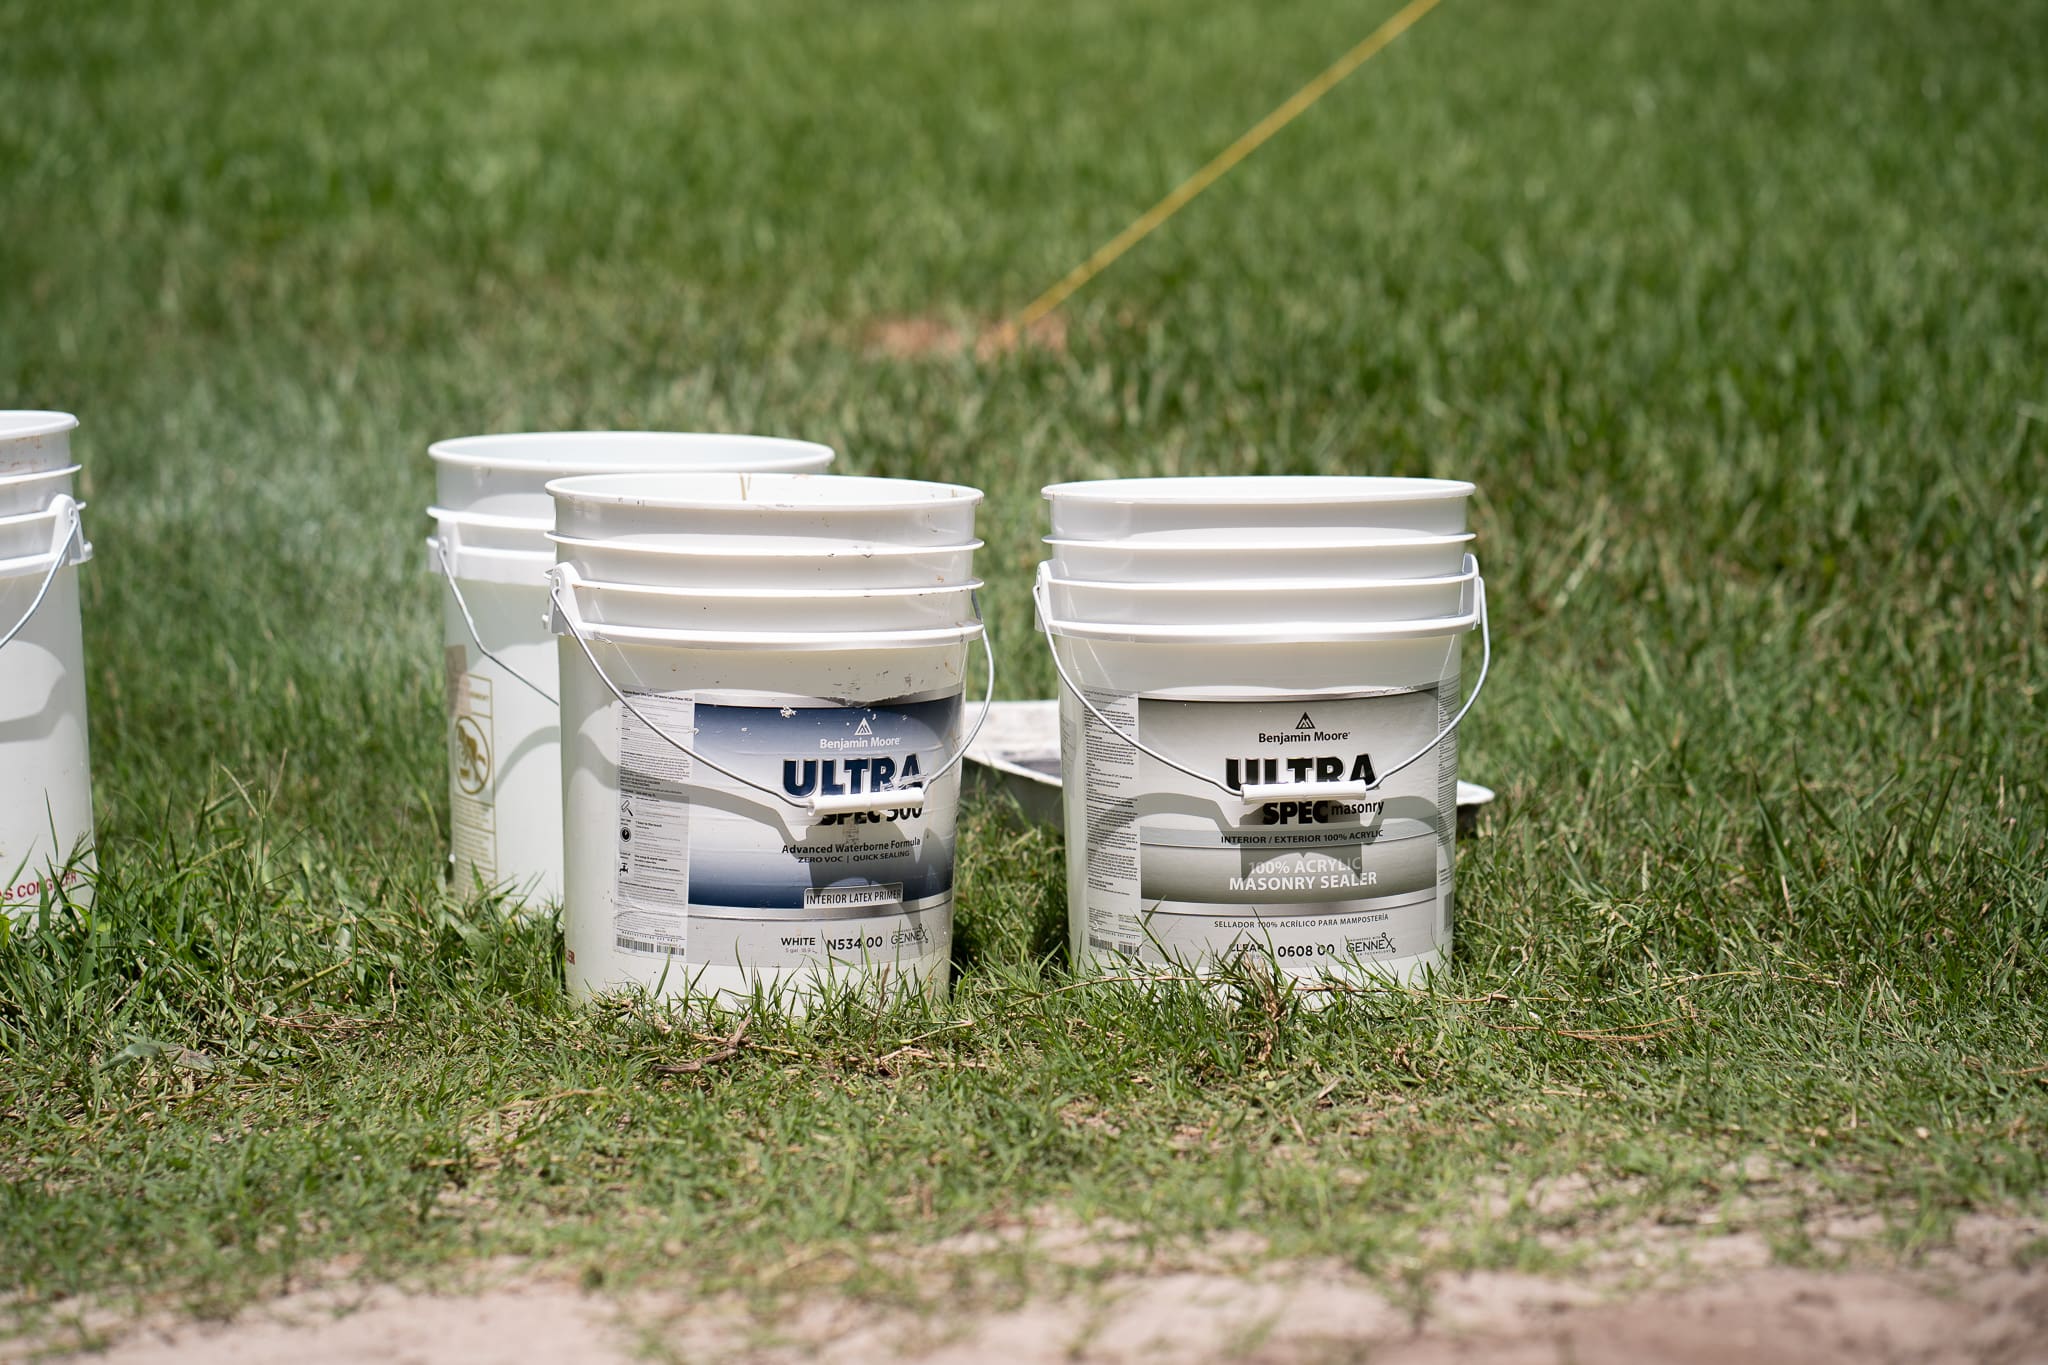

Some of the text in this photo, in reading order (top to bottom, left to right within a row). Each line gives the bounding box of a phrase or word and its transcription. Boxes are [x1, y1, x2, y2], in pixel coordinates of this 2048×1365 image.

[819, 737, 900, 751] Benjamin Moore
[1258, 731, 1349, 745] Benjamin Moore
[783, 754, 923, 797] ULTRA
[1225, 753, 1379, 791] ULTRA
[1262, 801, 1385, 825] SPEC masonry
[782, 837, 921, 854] Advanced Waterborne Formula
[1221, 835, 1267, 845] INTERIOR
[1274, 834, 1321, 844] EXTERIOR
[1324, 833, 1347, 842] 100%
[1349, 830, 1384, 840] ACRYLIC
[798, 850, 910, 864] ZERO VOC QUICK SEALING
[1249, 857, 1361, 875] 100% ACRYLIC
[1229, 872, 1377, 891] MASONRY SEALER
[806, 889, 902, 905] INTERIOR LATEX PRIMER
[1214, 912, 1389, 929] SELLADOR 100% ACRÍLICO PARA MAMPOSTERÍA
[781, 937, 816, 946] WHITE
[827, 939, 862, 950] N534
[891, 923, 929, 944] GENNEX
[1346, 931, 1396, 953] GENNEX
[1277, 946, 1313, 958] 0608
[1317, 944, 1335, 956] 00
